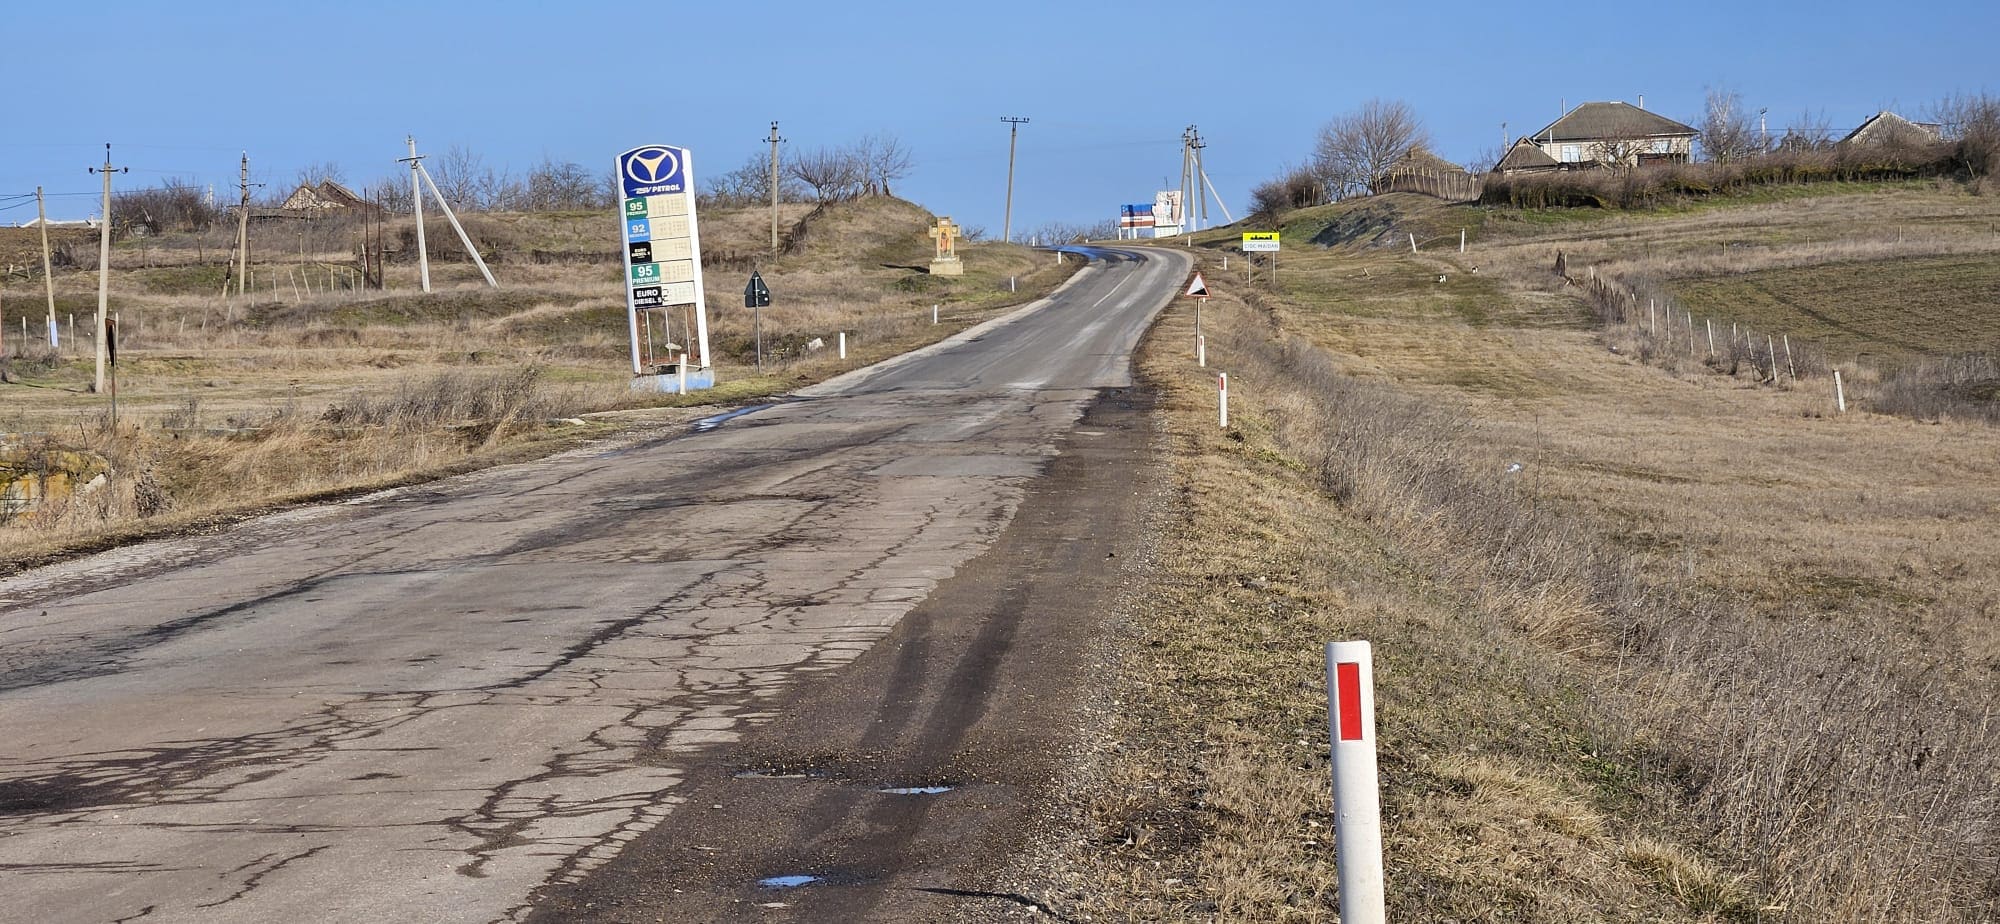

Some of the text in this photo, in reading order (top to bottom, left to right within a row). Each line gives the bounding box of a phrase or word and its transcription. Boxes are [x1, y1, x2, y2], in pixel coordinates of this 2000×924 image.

[652, 184, 680, 192] PETROL
[629, 202, 643, 211] 95
[632, 224, 645, 233] 92
[637, 265, 653, 277] 95
[632, 276, 660, 284] PREMIUM
[636, 289, 658, 298] EURO
[634, 297, 657, 305] DIESEL
